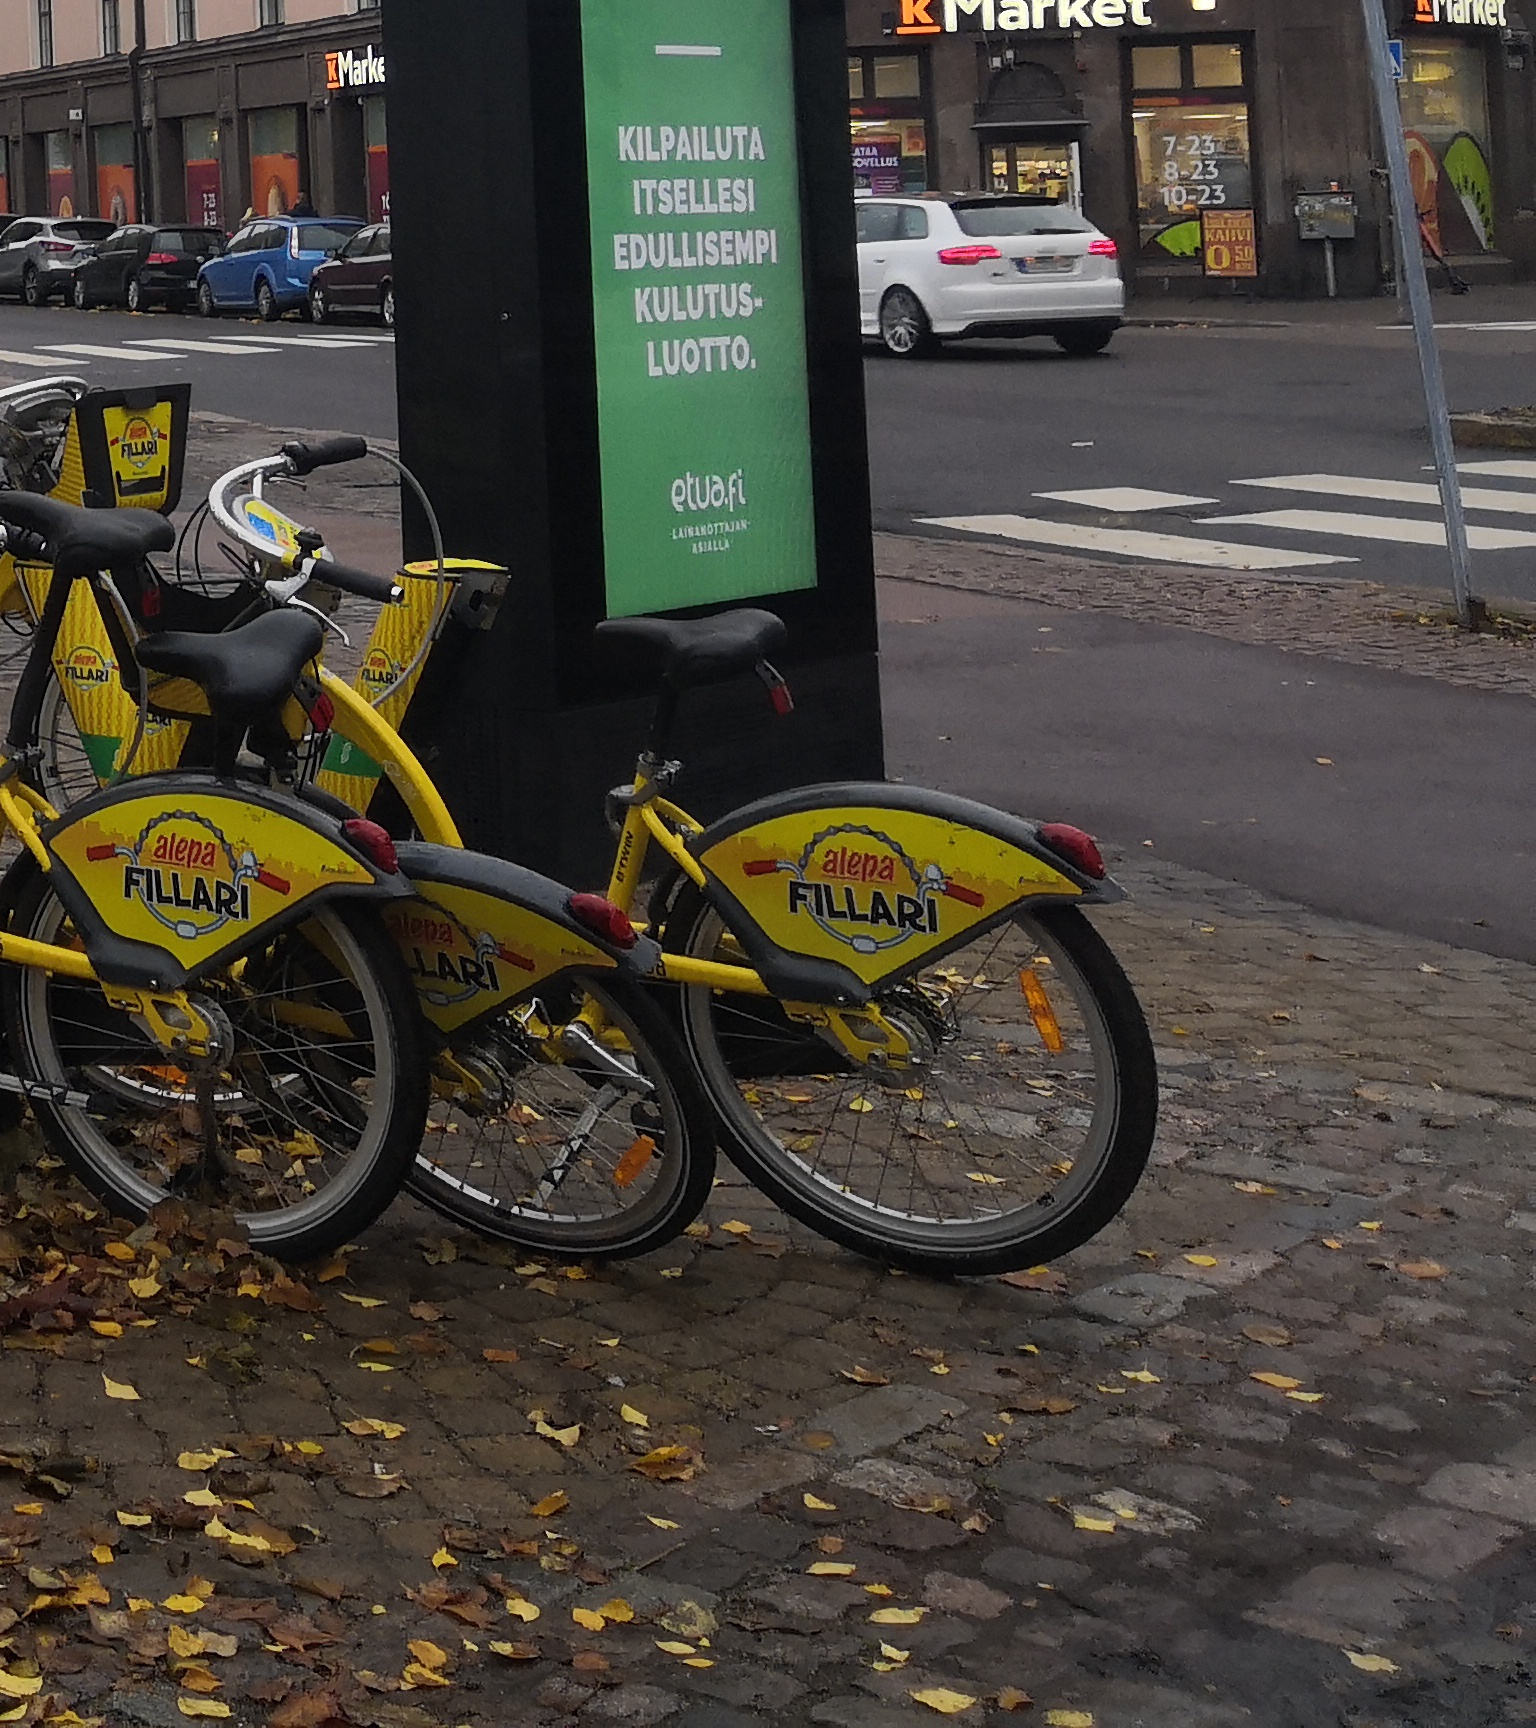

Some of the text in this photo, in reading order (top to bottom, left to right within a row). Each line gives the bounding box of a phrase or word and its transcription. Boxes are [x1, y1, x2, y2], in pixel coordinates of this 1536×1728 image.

[338, 44, 386, 88] Marke
[618, 125, 765, 161] KILPAILUTA
[1162, 135, 1216, 155] 7-23
[1164, 160, 1219, 181] 8-23
[633, 178, 755, 215] ITSELLESI
[1160, 184, 1226, 206] 10-23
[613, 229, 778, 270] EDULLISEMPI
[1206, 244, 1232, 270] 0
[635, 283, 764, 323] KULUTUS-
[647, 335, 757, 377] LUOTTO.
[121, 440, 158, 458] FILLARI
[671, 470, 746, 512] etua.fi
[692, 540, 729, 554] ASIALLA
[65, 667, 109, 682] FILLARI
[153, 832, 216, 869] alepa
[821, 846, 895, 882] alepa
[123, 865, 250, 921] FILLARI
[788, 879, 938, 934] FILLARI
